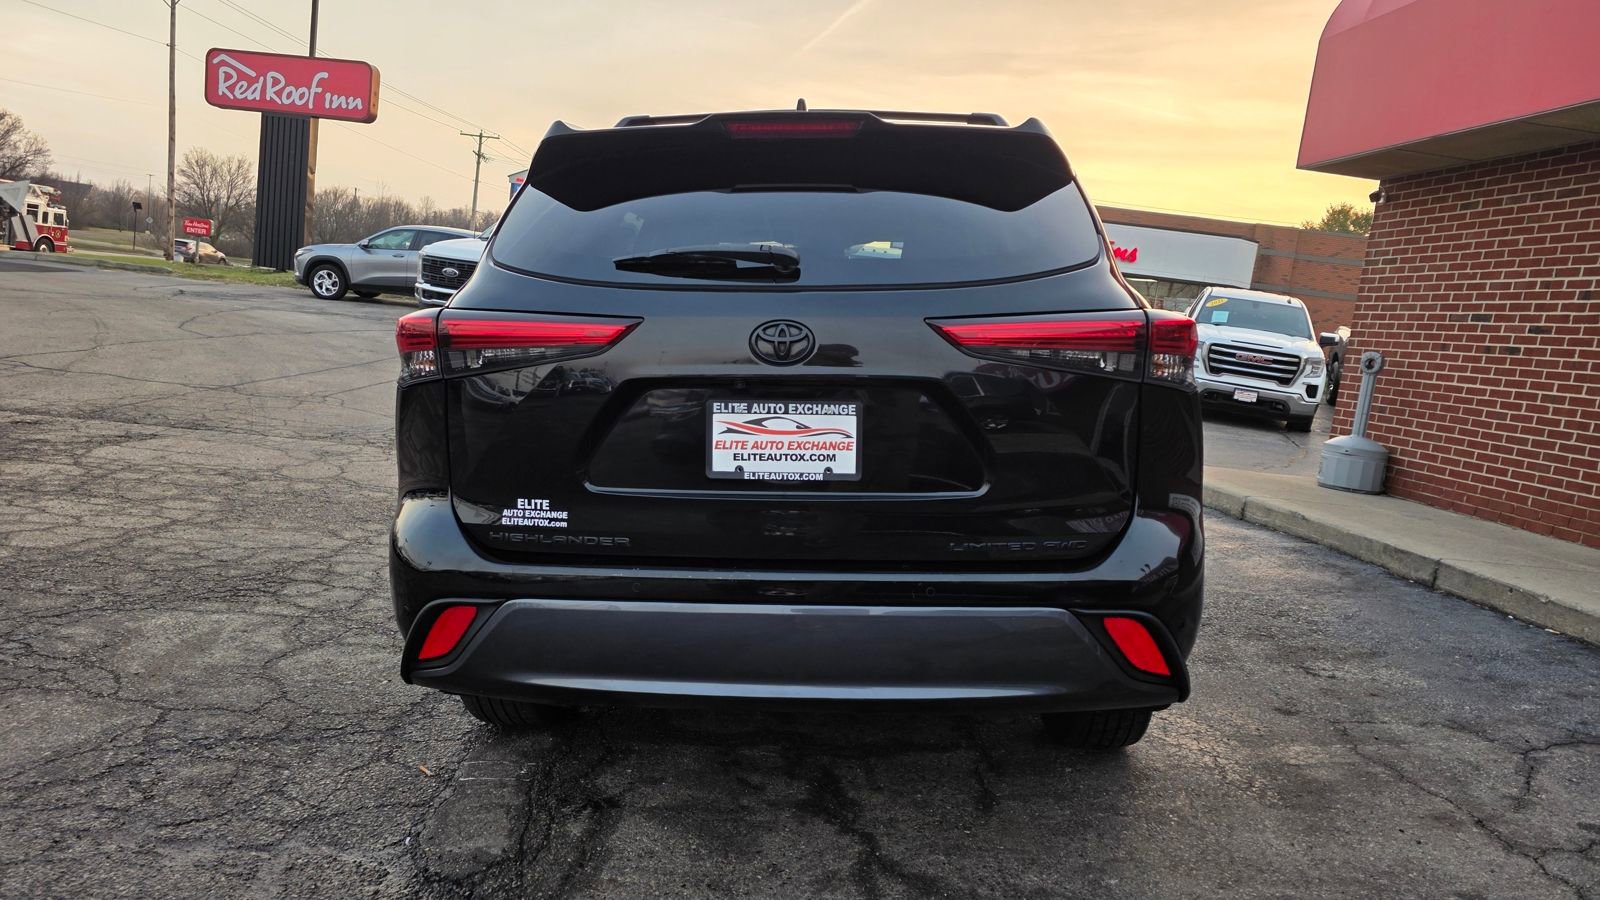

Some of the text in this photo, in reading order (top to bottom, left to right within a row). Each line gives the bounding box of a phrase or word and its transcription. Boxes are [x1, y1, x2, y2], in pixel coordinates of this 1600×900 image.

[186, 227, 207, 235] ENTER
[1235, 353, 1273, 365] GMC
[713, 402, 856, 415] ELITE AUTO EXCHANGE
[714, 440, 854, 451] ELITE AUTO EXCHANGE
[733, 453, 836, 462] ELITEAUTOX.COM
[744, 472, 824, 480] ELITEAUTOX.COM
[517, 498, 550, 510] ELITE
[502, 509, 568, 519] AUTO EXCHANGE
[502, 518, 567, 527] ELITEAUTOX.com
[489, 531, 631, 547] HIGHLANDER
[950, 541, 1036, 551] LIMITED
